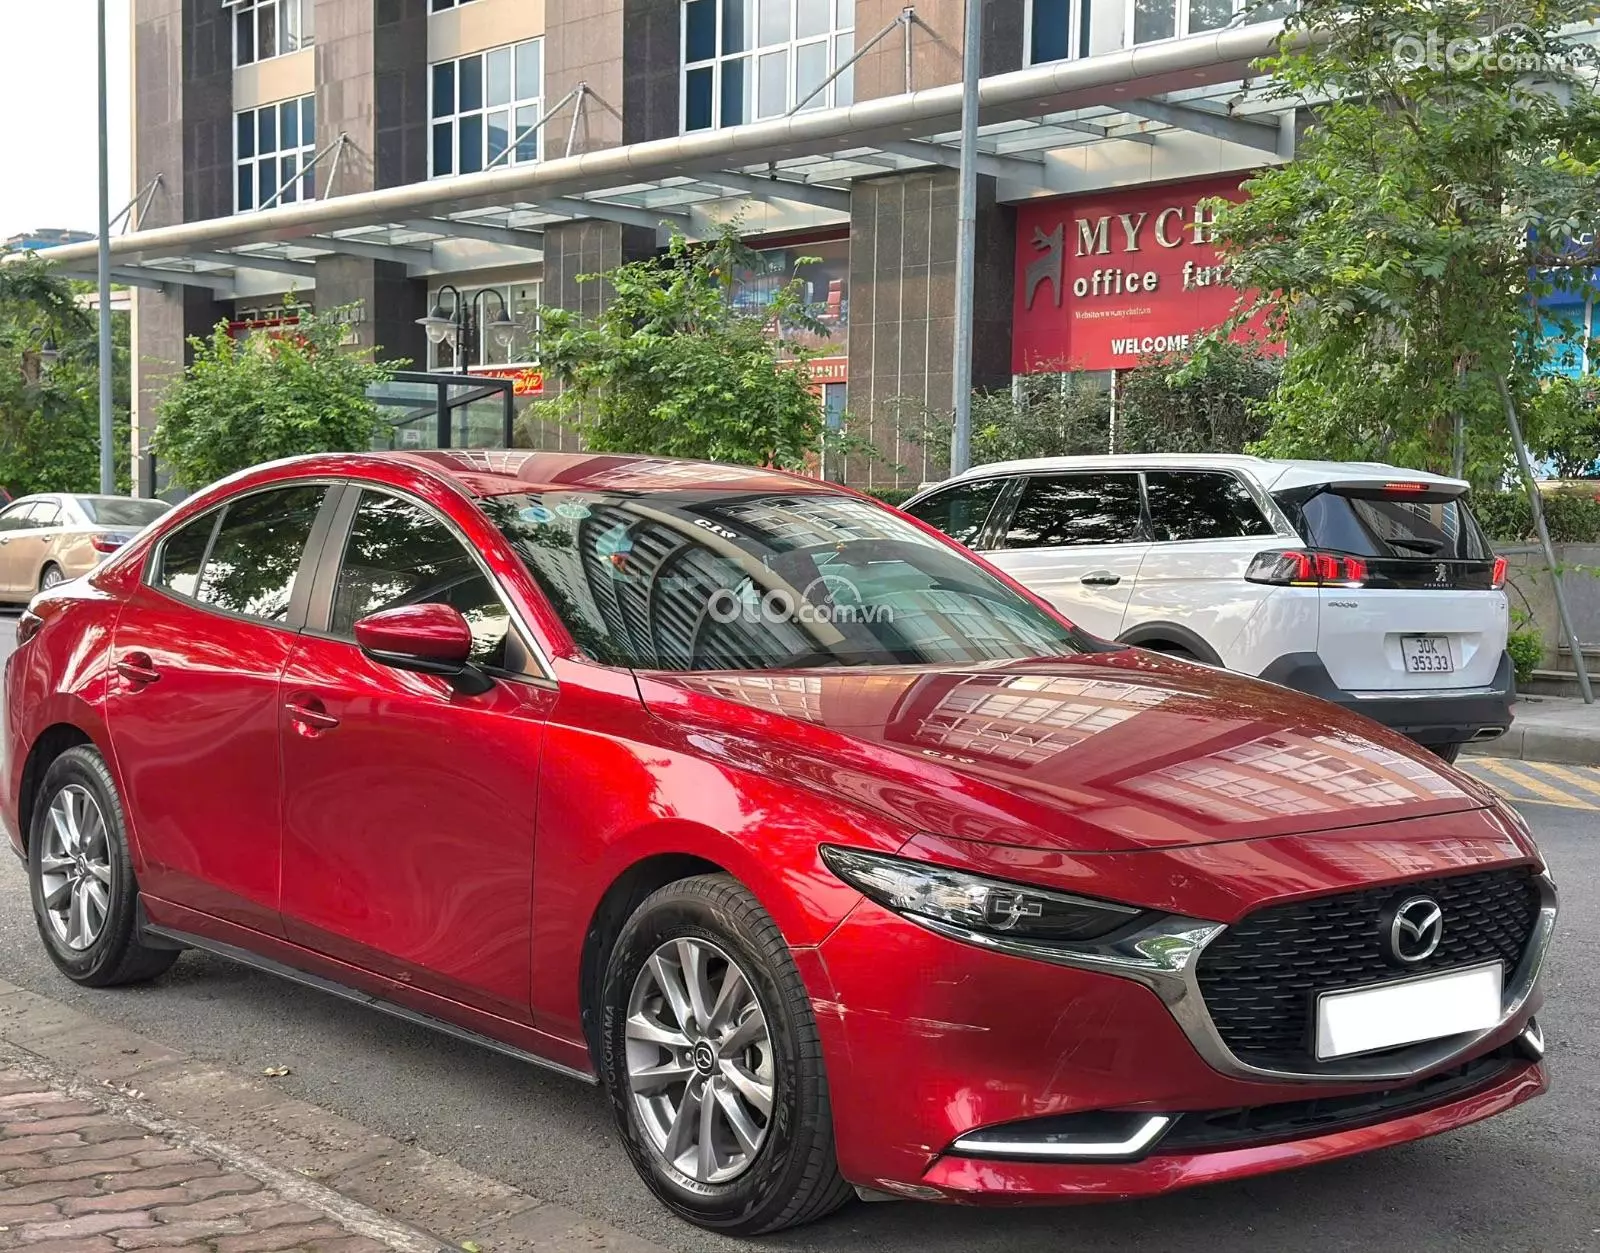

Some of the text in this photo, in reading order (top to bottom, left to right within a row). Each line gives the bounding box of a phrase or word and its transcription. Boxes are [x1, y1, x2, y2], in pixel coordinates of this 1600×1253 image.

[1074, 204, 1219, 257] MYCH
[1073, 261, 1236, 297] office fur
[1111, 334, 1189, 355] WELCOME
[1416, 639, 1438, 654] 30K
[1411, 655, 1449, 671] 353.33
